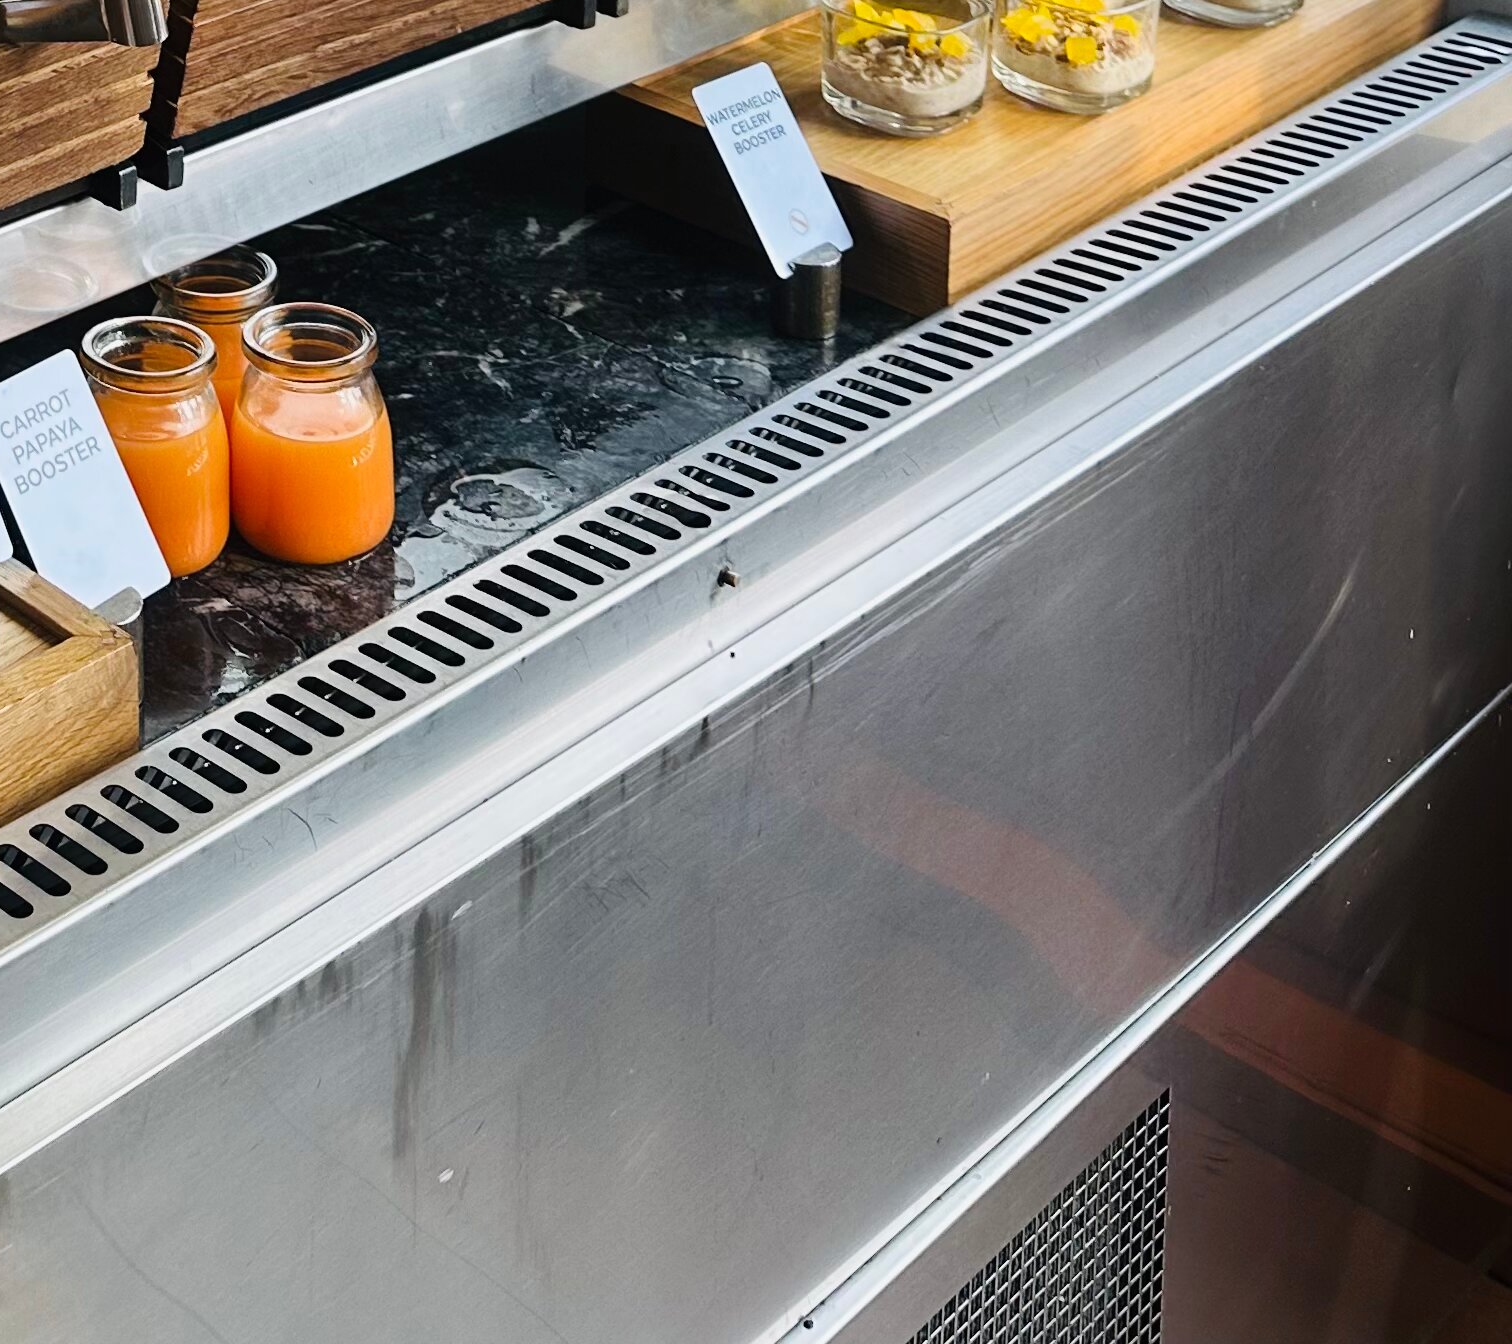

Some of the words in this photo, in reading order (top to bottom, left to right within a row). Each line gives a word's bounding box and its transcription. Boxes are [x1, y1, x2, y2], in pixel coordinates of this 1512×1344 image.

[706, 88, 781, 125] WATERMELON
[731, 111, 773, 136] CELERY
[734, 124, 786, 154] BOOSTER
[0, 389, 74, 441] CARROT
[11, 416, 83, 466] PAPAYA
[13, 435, 102, 496] BOOSTER
